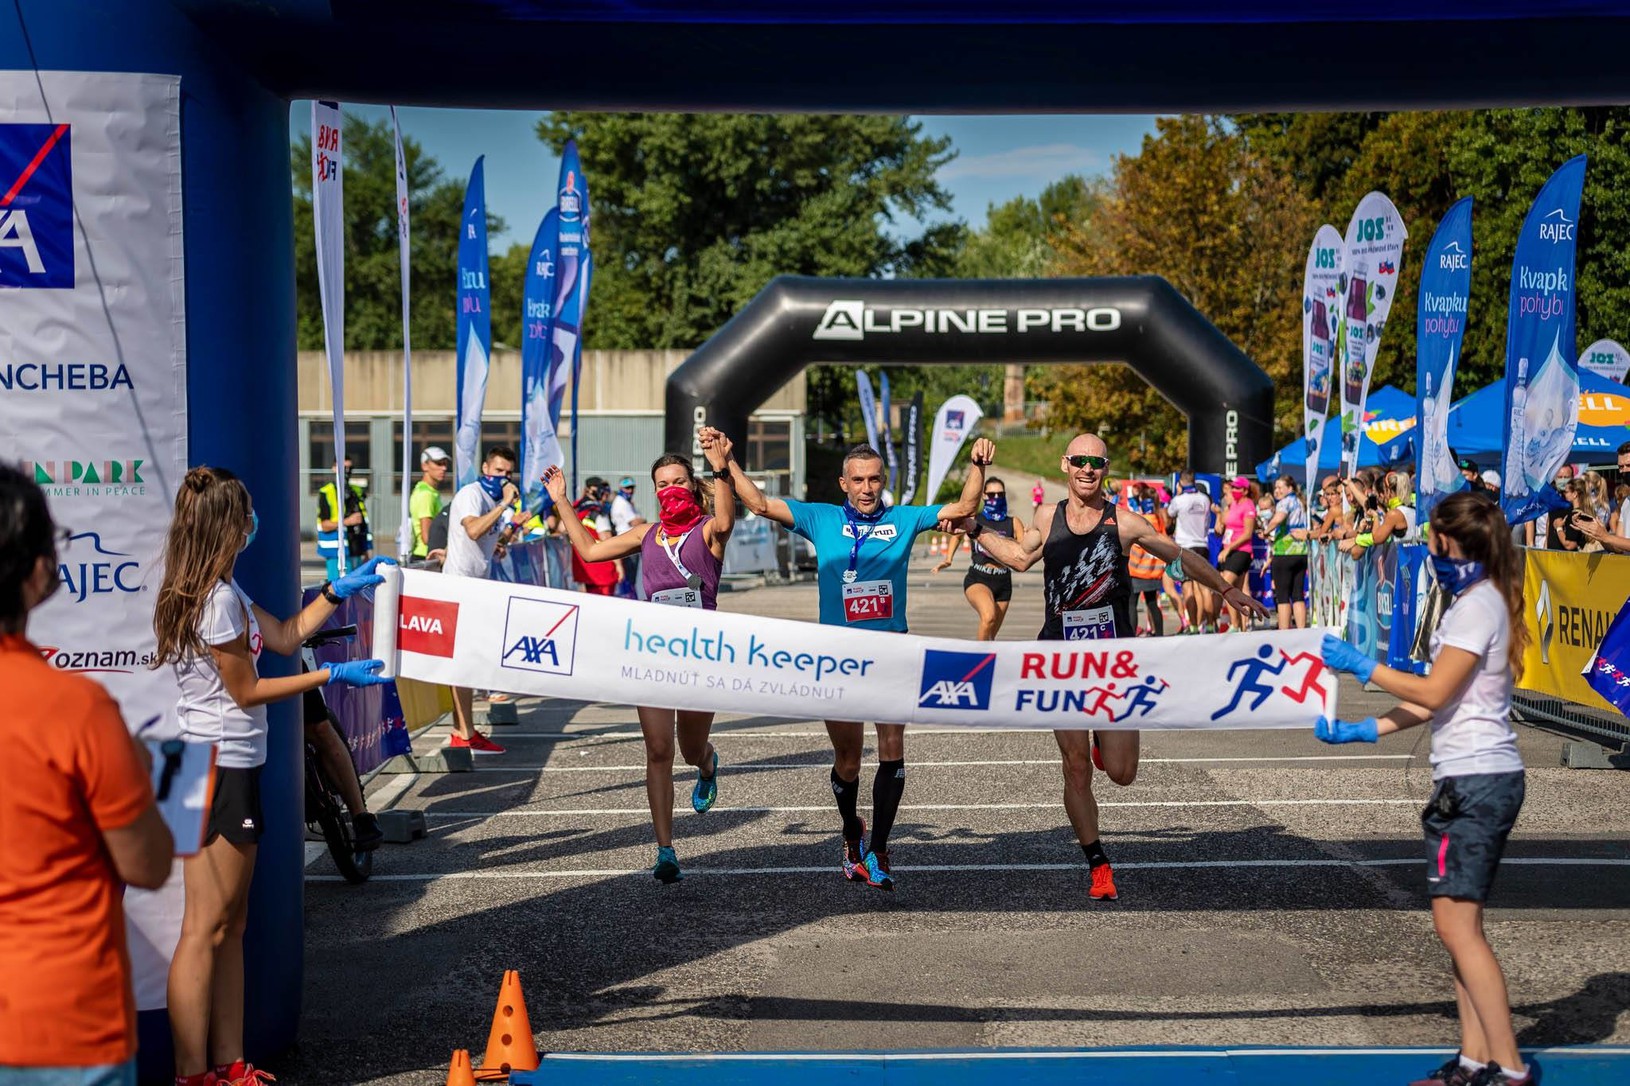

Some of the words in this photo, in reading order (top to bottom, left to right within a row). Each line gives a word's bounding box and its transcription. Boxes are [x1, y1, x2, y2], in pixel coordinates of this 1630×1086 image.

[1357, 217, 1384, 242] JOS
[1540, 223, 1574, 244] RAJEC
[1315, 247, 1335, 269] JOS
[1440, 254, 1467, 273] RAJEC
[1520, 265, 1568, 296] Kvapk
[1424, 291, 1467, 317] Kvapku
[812, 299, 1007, 340] ALPINE
[1017, 307, 1121, 333] PRO
[1225, 409, 1239, 460] PRO
[64, 459, 145, 484] PARK
[86, 486, 100, 496] IN
[105, 486, 146, 496] PEACE
[873, 528, 895, 537] run
[973, 563, 992, 575] NIKE
[849, 597, 878, 614] 421
[1069, 626, 1098, 640] 421
[502, 635, 560, 667] AXA
[624, 618, 736, 664] health
[747, 634, 875, 682] keeper
[1020, 650, 1140, 680] RUN&
[706, 675, 726, 689] SA
[732, 678, 753, 692] DÁ
[918, 680, 979, 706] AXA
[1015, 689, 1086, 712] FUN
